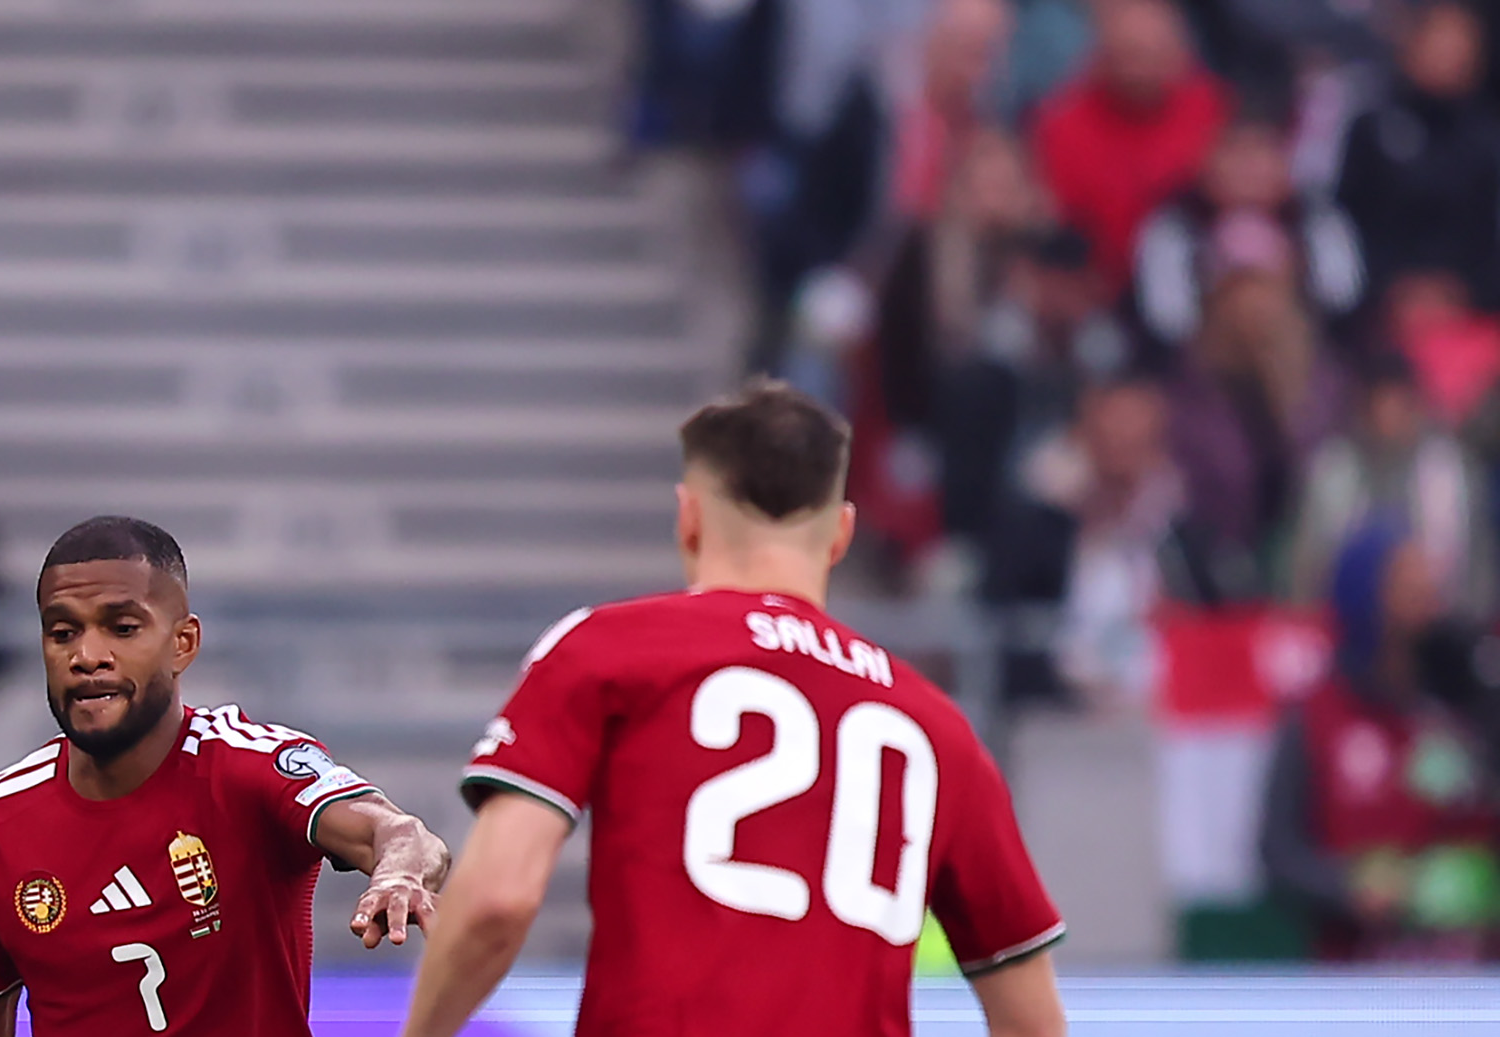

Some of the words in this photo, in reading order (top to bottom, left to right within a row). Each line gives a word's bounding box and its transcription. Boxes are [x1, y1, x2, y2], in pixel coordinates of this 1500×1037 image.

[745, 611, 894, 689] SALLAI
[683, 666, 939, 946] 20
[111, 942, 167, 1032] 7
